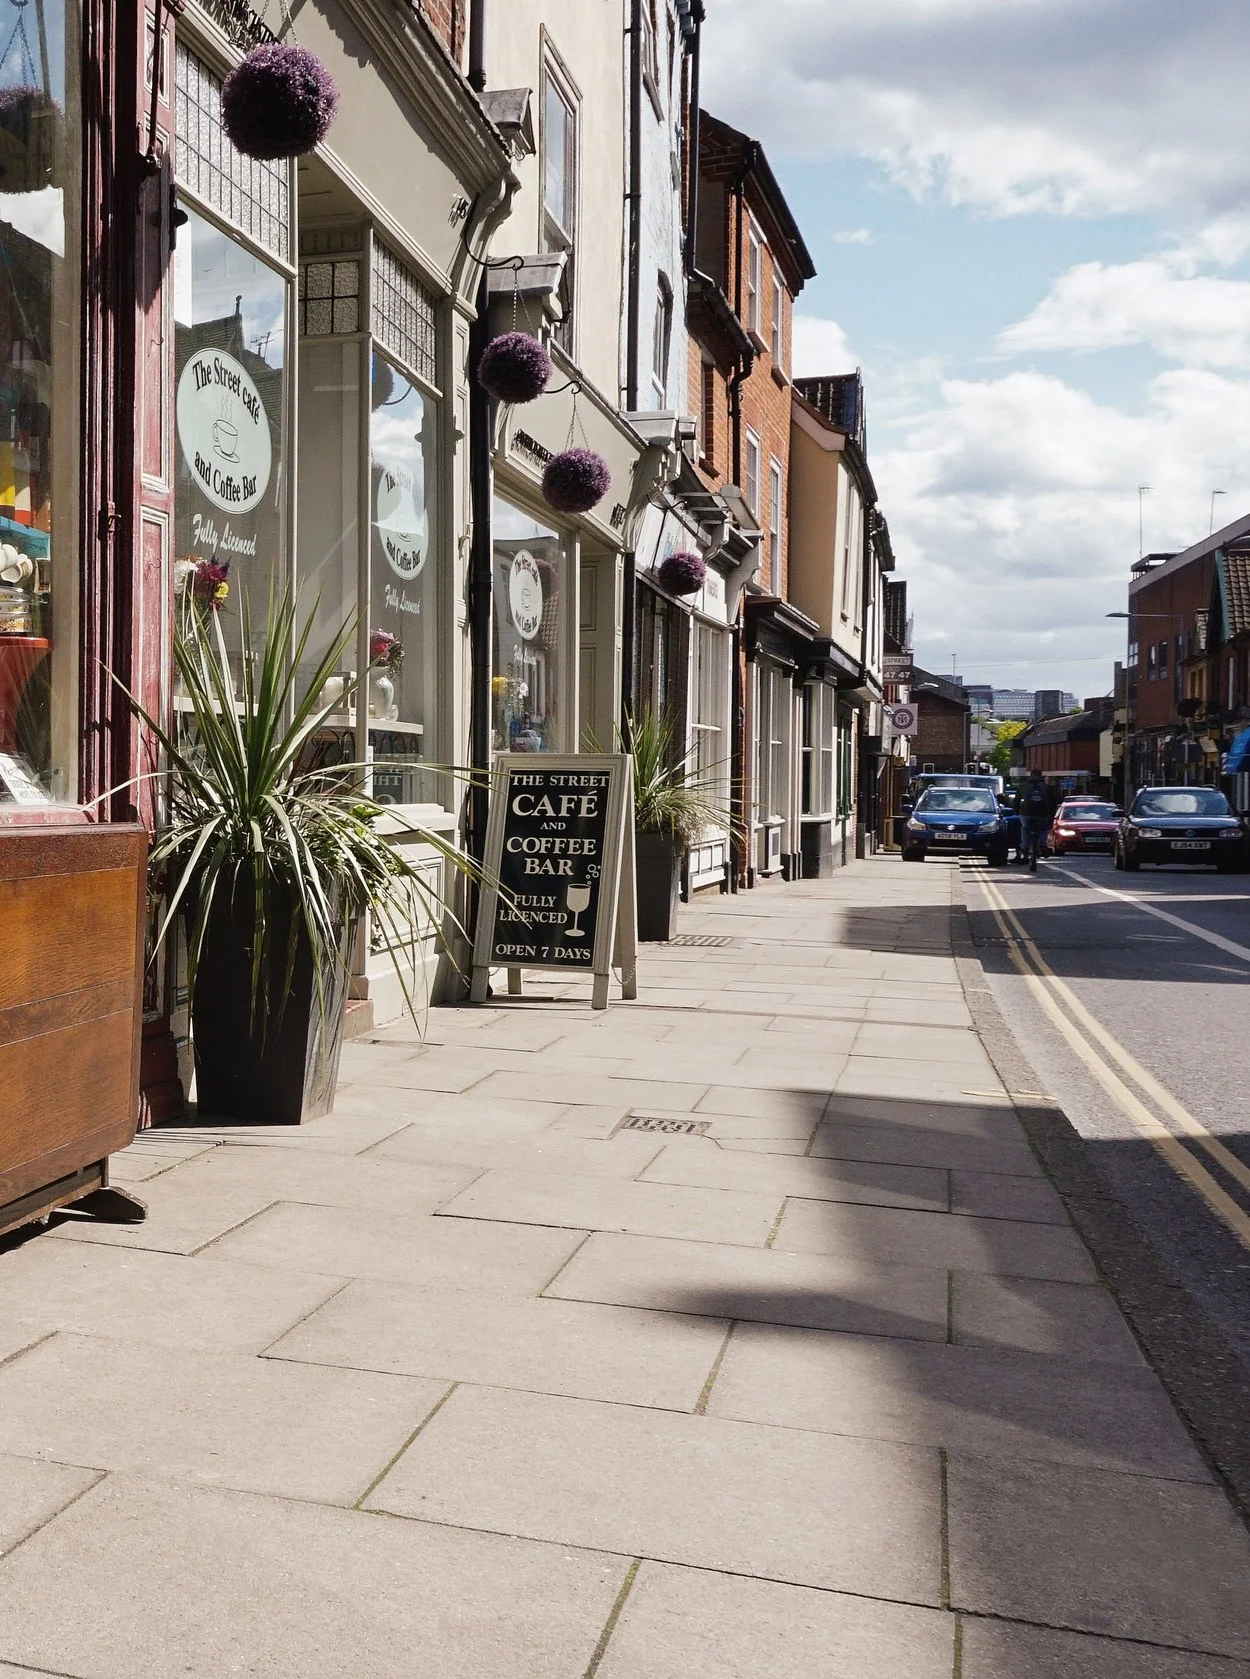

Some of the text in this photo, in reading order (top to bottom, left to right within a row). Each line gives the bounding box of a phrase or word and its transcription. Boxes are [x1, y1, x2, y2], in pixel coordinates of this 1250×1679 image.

[192, 360, 213, 391] The
[214, 358, 241, 395] Street
[194, 451, 257, 502] and Coffee Bar
[385, 474, 395, 493] The
[192, 514, 218, 549] Fully
[386, 537, 421, 571] and Coffee Bar
[385, 584, 399, 612] Fully
[512, 775, 609, 787] THE STREET
[512, 790, 598, 818] CAFÉ
[540, 821, 566, 830] AND
[506, 837, 596, 855] COFFEE
[525, 857, 574, 876] BAR
[513, 895, 557, 908] FULLY
[499, 910, 568, 924] LICENCED
[495, 944, 591, 959] OPEN 7 DAYS
